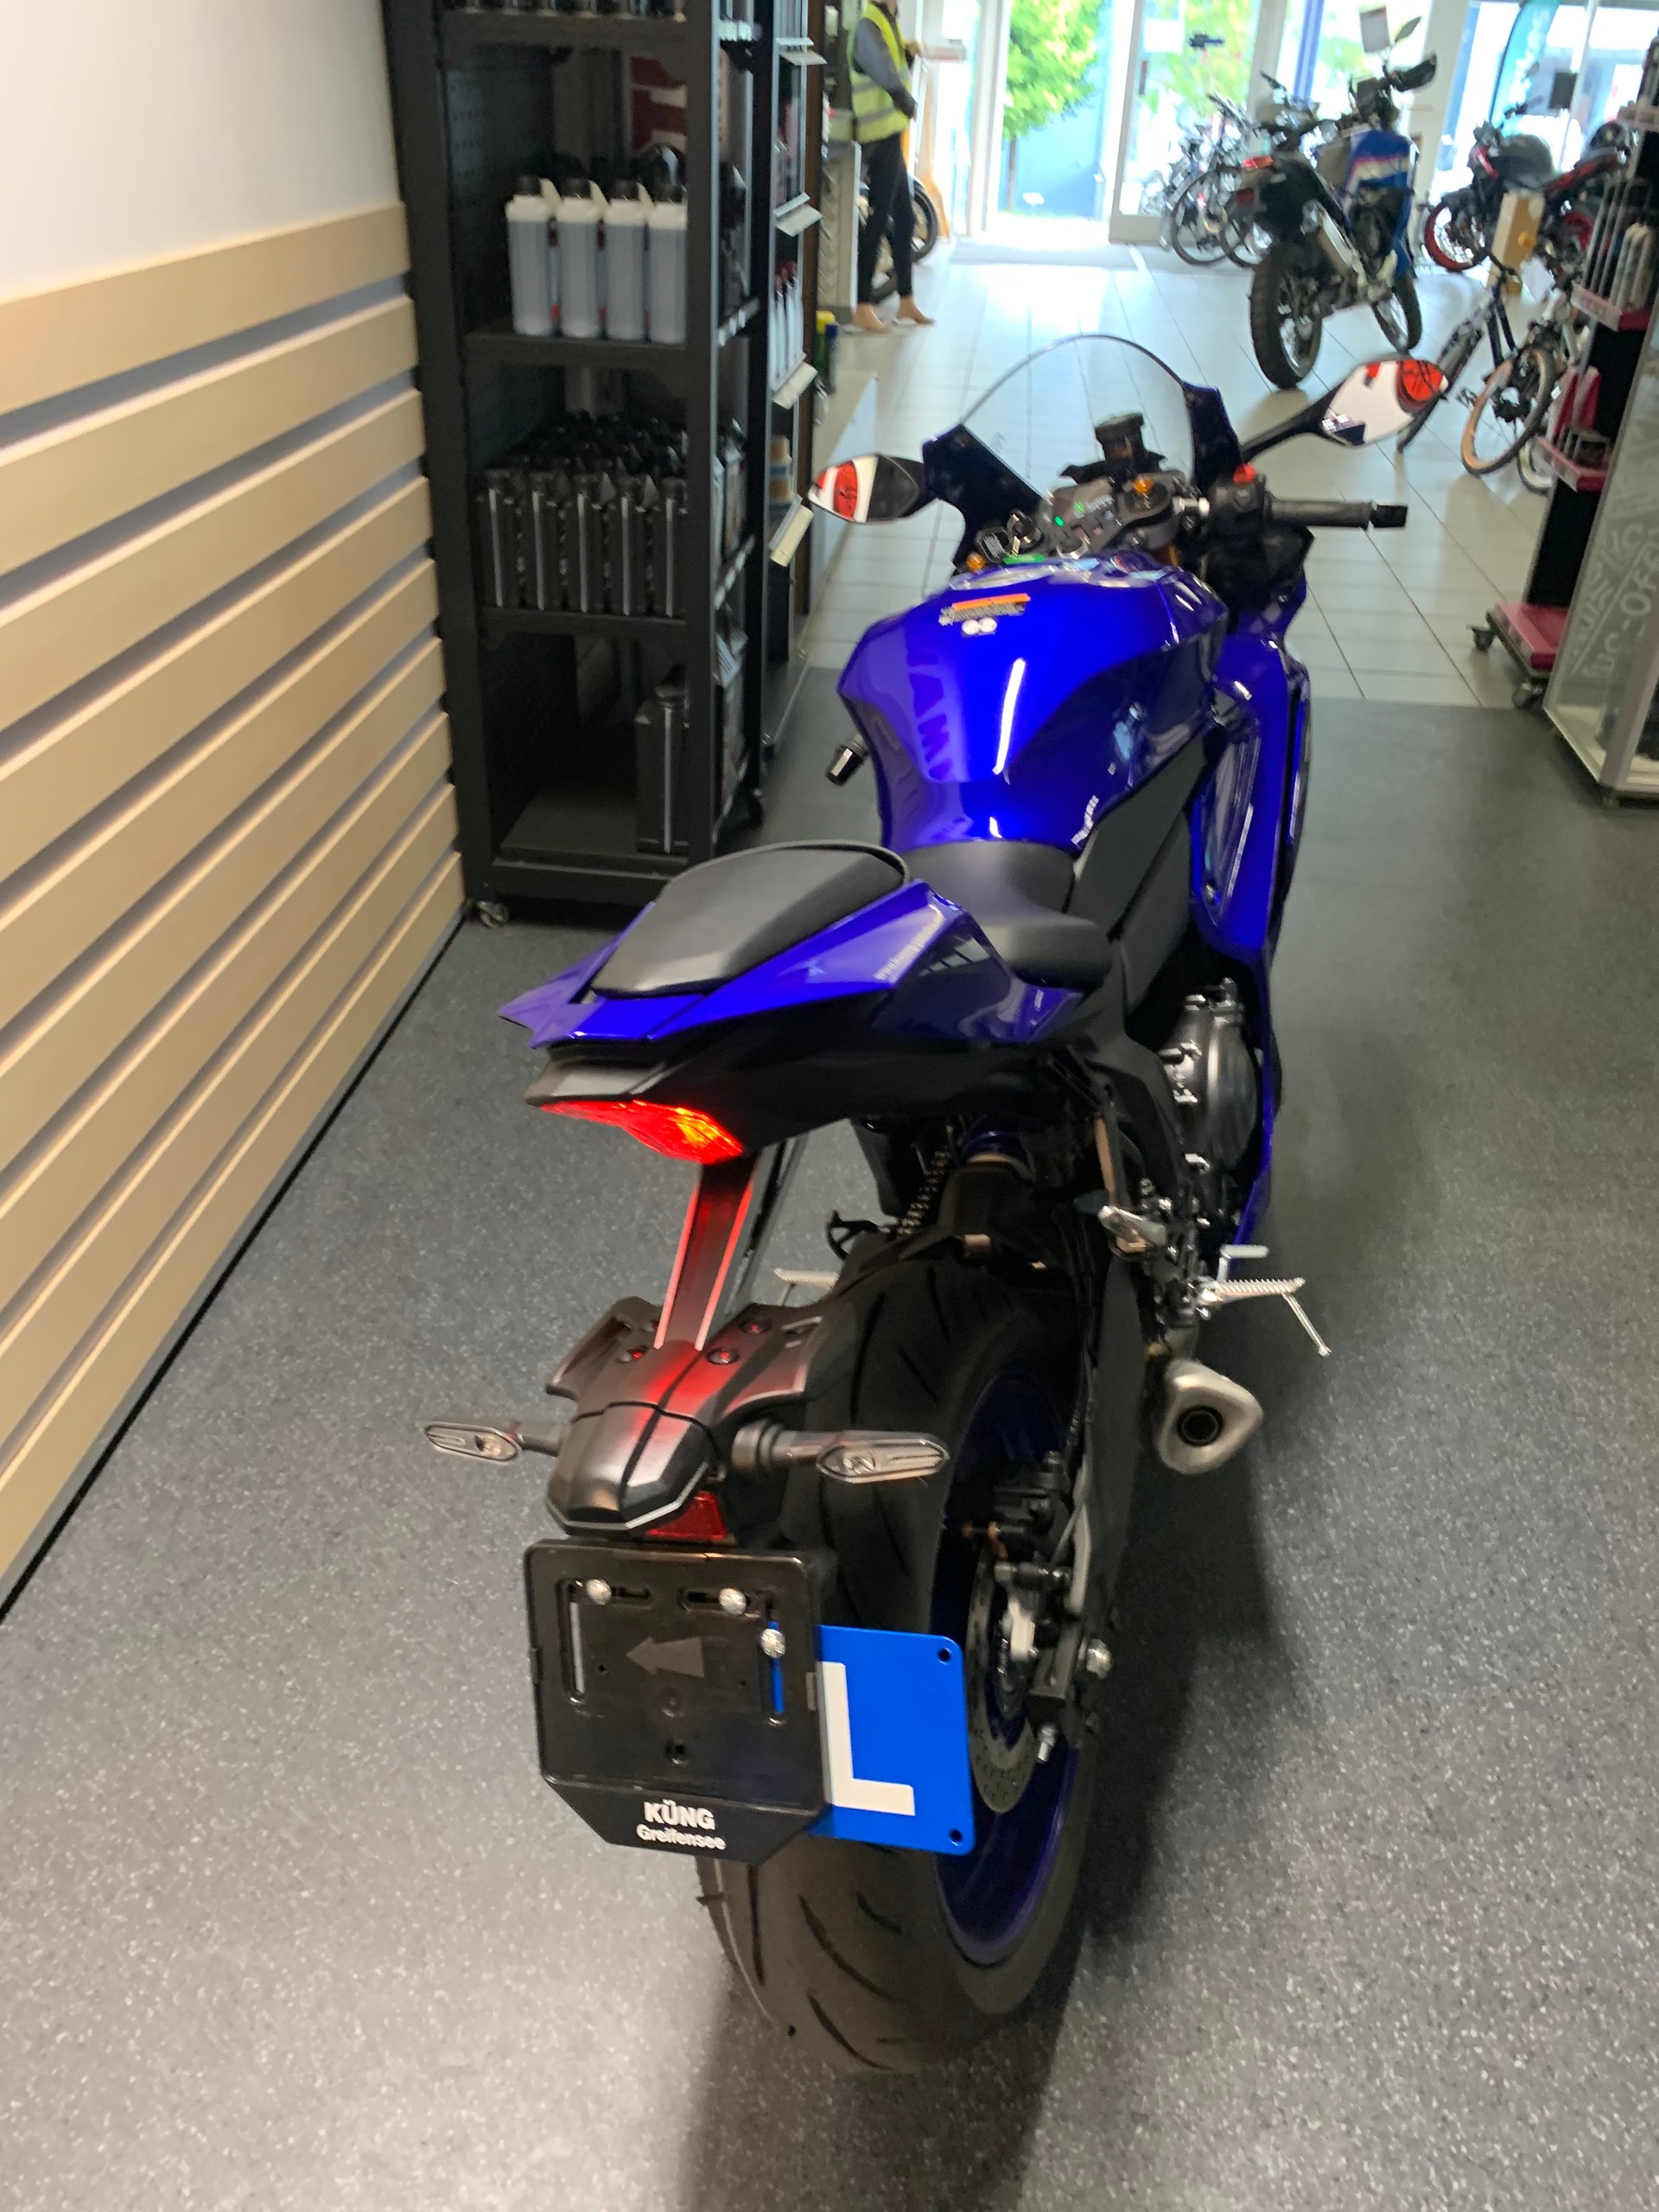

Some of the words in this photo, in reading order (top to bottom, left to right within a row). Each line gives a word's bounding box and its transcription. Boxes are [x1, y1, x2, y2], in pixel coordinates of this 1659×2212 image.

[817, 1661, 915, 1816] L
[643, 1798, 716, 1831] KÜNG
[636, 1823, 727, 1851] Greifensee
